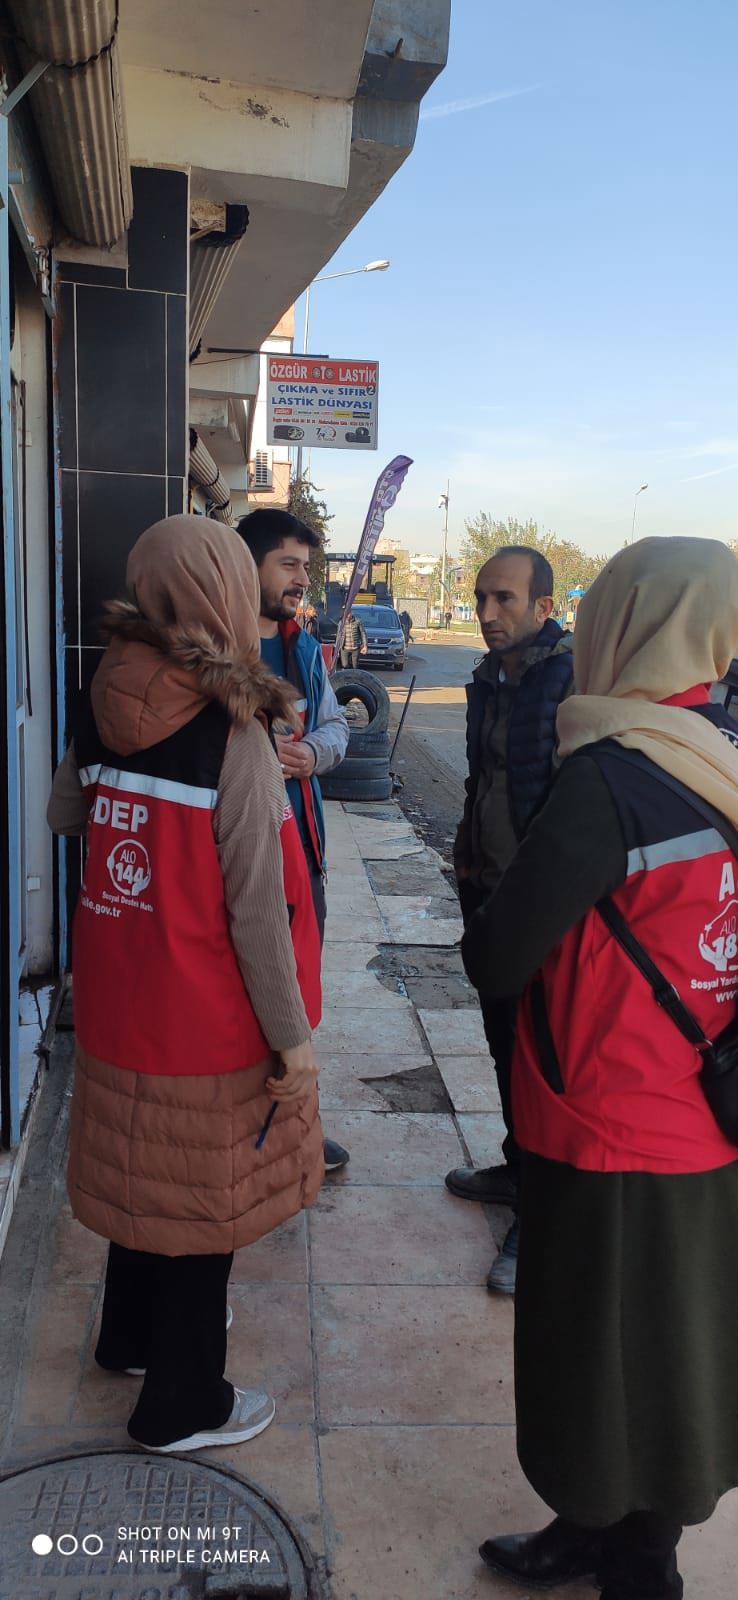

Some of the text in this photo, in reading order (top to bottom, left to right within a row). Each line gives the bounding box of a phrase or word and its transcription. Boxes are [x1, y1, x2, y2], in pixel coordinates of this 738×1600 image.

[270, 361, 376, 383] ÖZGÜR OTO LASTİK
[277, 384, 318, 396] ÇIKMA
[271, 396, 372, 409] LASTİK DÜNYASI
[90, 795, 149, 833] DEP
[120, 849, 137, 865] ALO
[115, 862, 145, 885] 144
[102, 891, 120, 903] Sosyal
[719, 915, 737, 937] ALO
[690, 978, 719, 991] Sosyal
